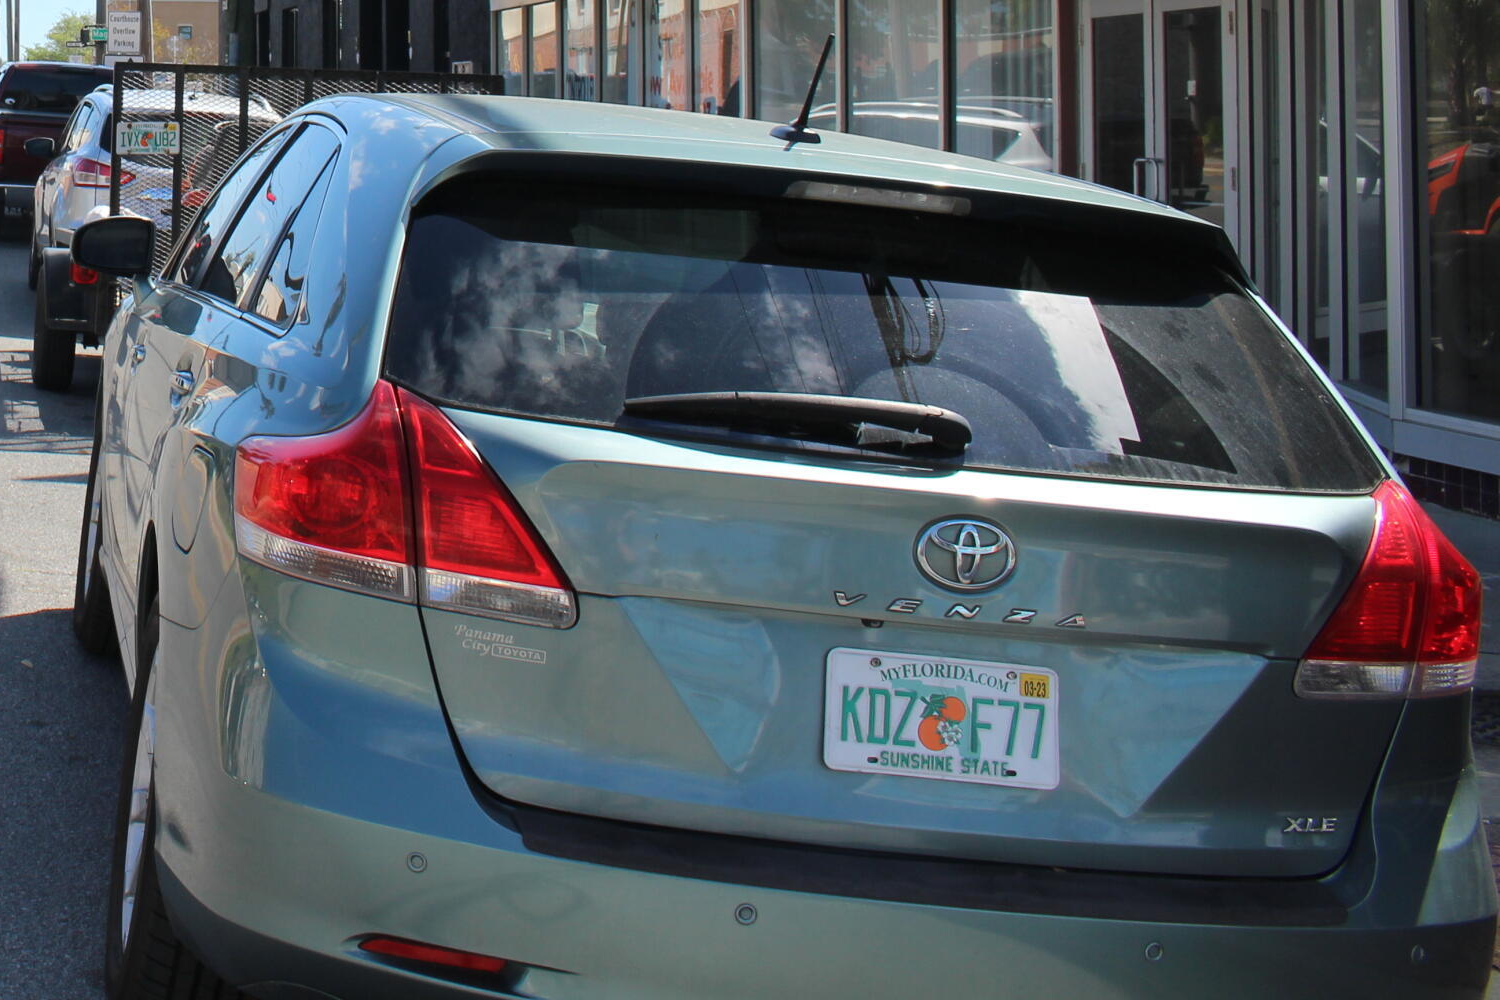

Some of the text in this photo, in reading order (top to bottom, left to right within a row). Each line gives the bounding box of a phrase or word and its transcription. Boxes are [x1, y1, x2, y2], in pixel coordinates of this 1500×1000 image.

[110, 14, 140, 23] Courthouse
[113, 40, 135, 49] Parking
[834, 590, 1086, 629] VENZA
[455, 624, 515, 645] Panama
[462, 638, 541, 661] City TOYOTA
[1023, 679, 1047, 698] 03-23
[840, 685, 1046, 760] KDZ F77
[879, 750, 1010, 778] SUNSHINE STATE
[1283, 816, 1338, 832] XLE
